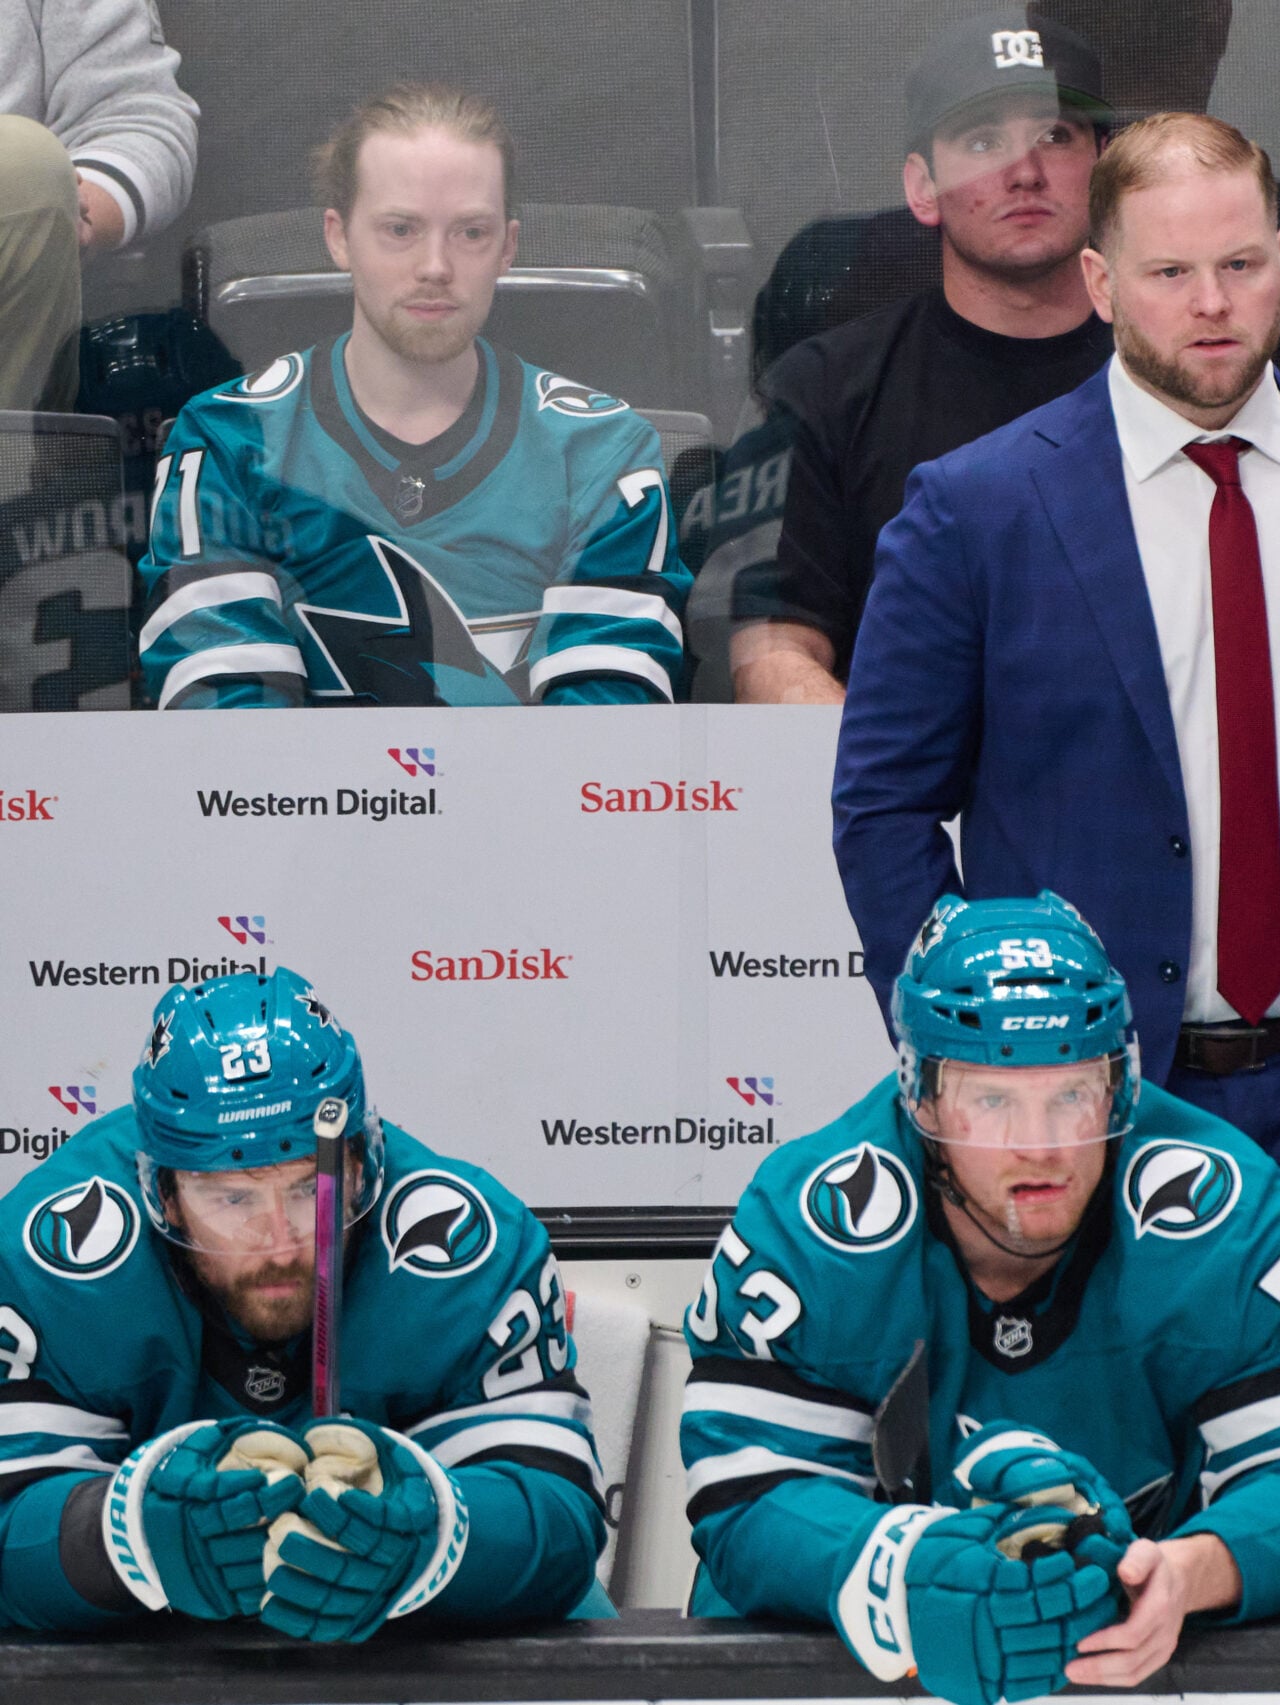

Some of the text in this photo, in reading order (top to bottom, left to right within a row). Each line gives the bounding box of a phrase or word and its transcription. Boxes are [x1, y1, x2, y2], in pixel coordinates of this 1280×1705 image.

[197, 788, 437, 821] Western Digital
[580, 781, 738, 812] SanDisk
[411, 949, 569, 981] SanDisk
[709, 951, 839, 977] Western
[1000, 938, 1053, 969] 53
[29, 960, 160, 987] Western
[1001, 1015, 1069, 1031] CCM
[219, 1039, 272, 1081] 23
[217, 1100, 292, 1124] WARRIOR
[0, 1127, 71, 1160] Digit
[540, 1117, 774, 1149] Western Digital
[688, 1223, 801, 1361] 53
[483, 1253, 568, 1401] 23
